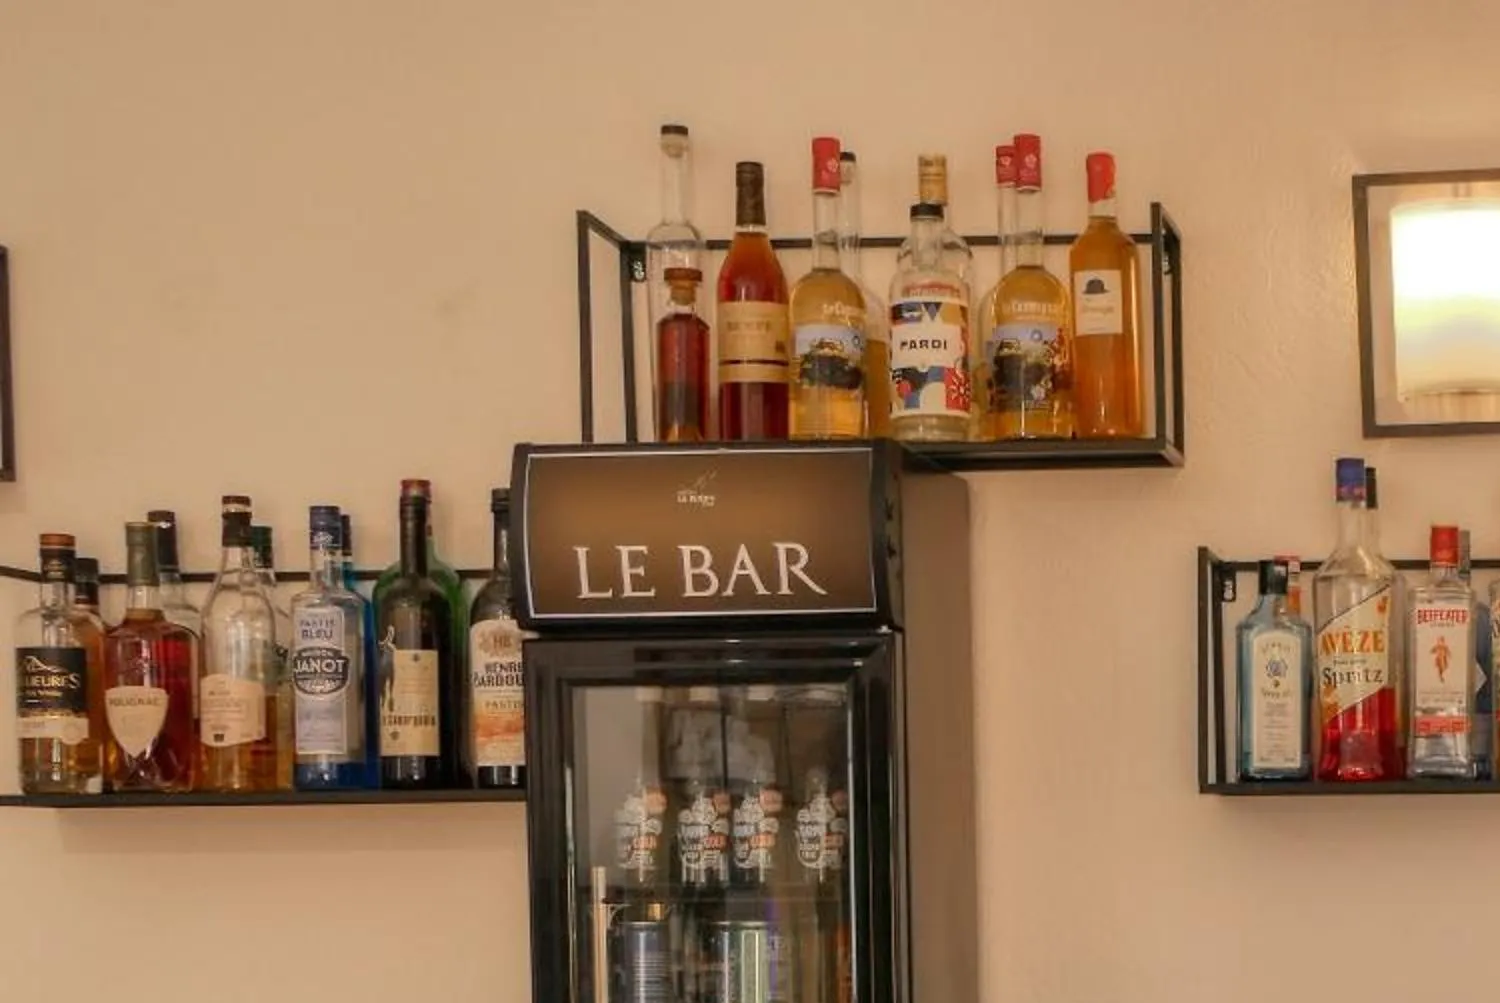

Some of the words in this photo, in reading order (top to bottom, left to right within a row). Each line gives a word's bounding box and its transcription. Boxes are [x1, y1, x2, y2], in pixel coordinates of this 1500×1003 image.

[572, 545, 656, 599] LE
[677, 542, 828, 598] BAR
[294, 658, 346, 674] JANOT
[1322, 667, 1384, 688] Spritz
